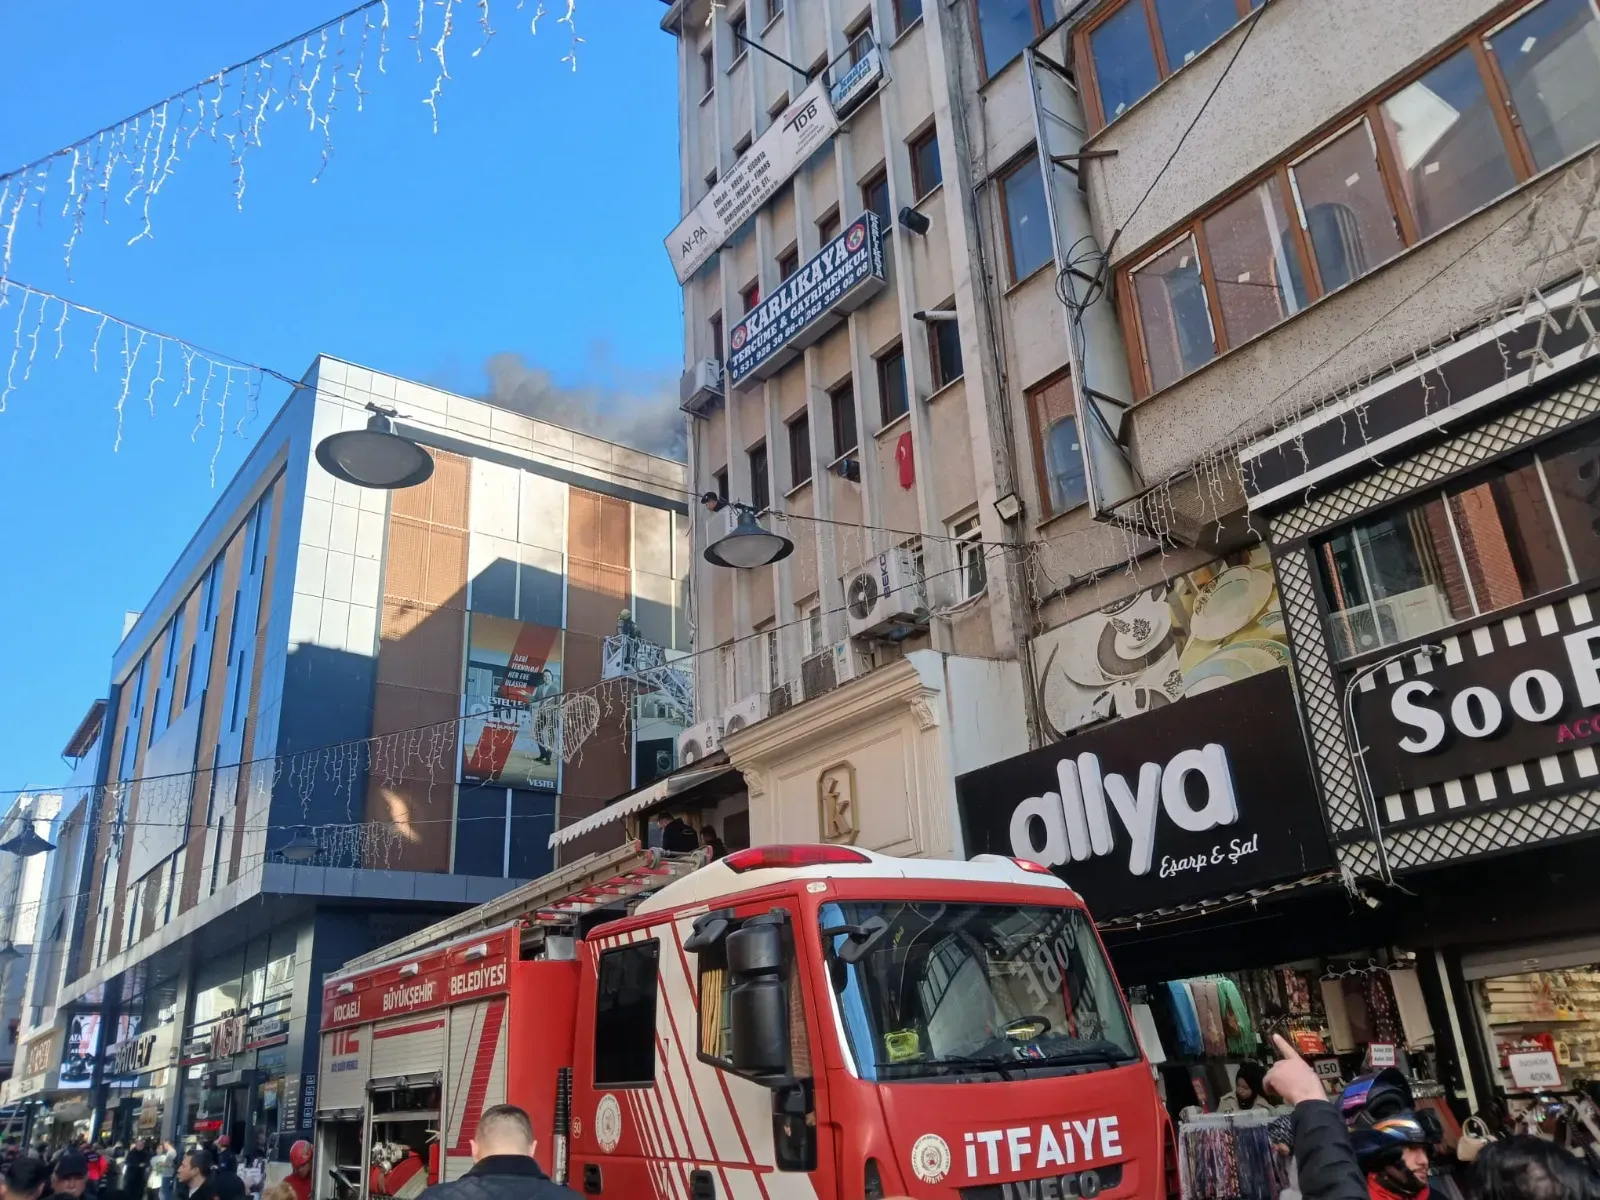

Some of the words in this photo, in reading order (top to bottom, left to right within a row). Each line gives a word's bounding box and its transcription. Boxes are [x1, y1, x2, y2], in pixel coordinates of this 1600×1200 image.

[681, 226, 707, 258] AY-PA
[732, 324, 778, 367] TERCÜME
[780, 318, 788, 329] &
[790, 248, 868, 320] GAYRİMENKUL
[746, 237, 849, 342] KARLIKAYA
[732, 368, 739, 379] 0
[805, 302, 822, 320] 262
[879, 553, 891, 599] BEKO
[508, 671, 519, 679] HER
[520, 672, 530, 680] EVE
[528, 779, 555, 789] VESTEL
[1009, 743, 1239, 876] allya
[1159, 855, 1207, 878] Eşarp
[1210, 845, 1225, 864] &
[1228, 833, 1258, 865] Şal
[333, 996, 361, 1023] KOCAELİ
[383, 979, 433, 1011] BÜYÜKŞEHİR
[450, 957, 507, 996] BELEDİYESİ
[1317, 1062, 1337, 1075] 150
[1002, 1169, 1101, 1200] IVECO
